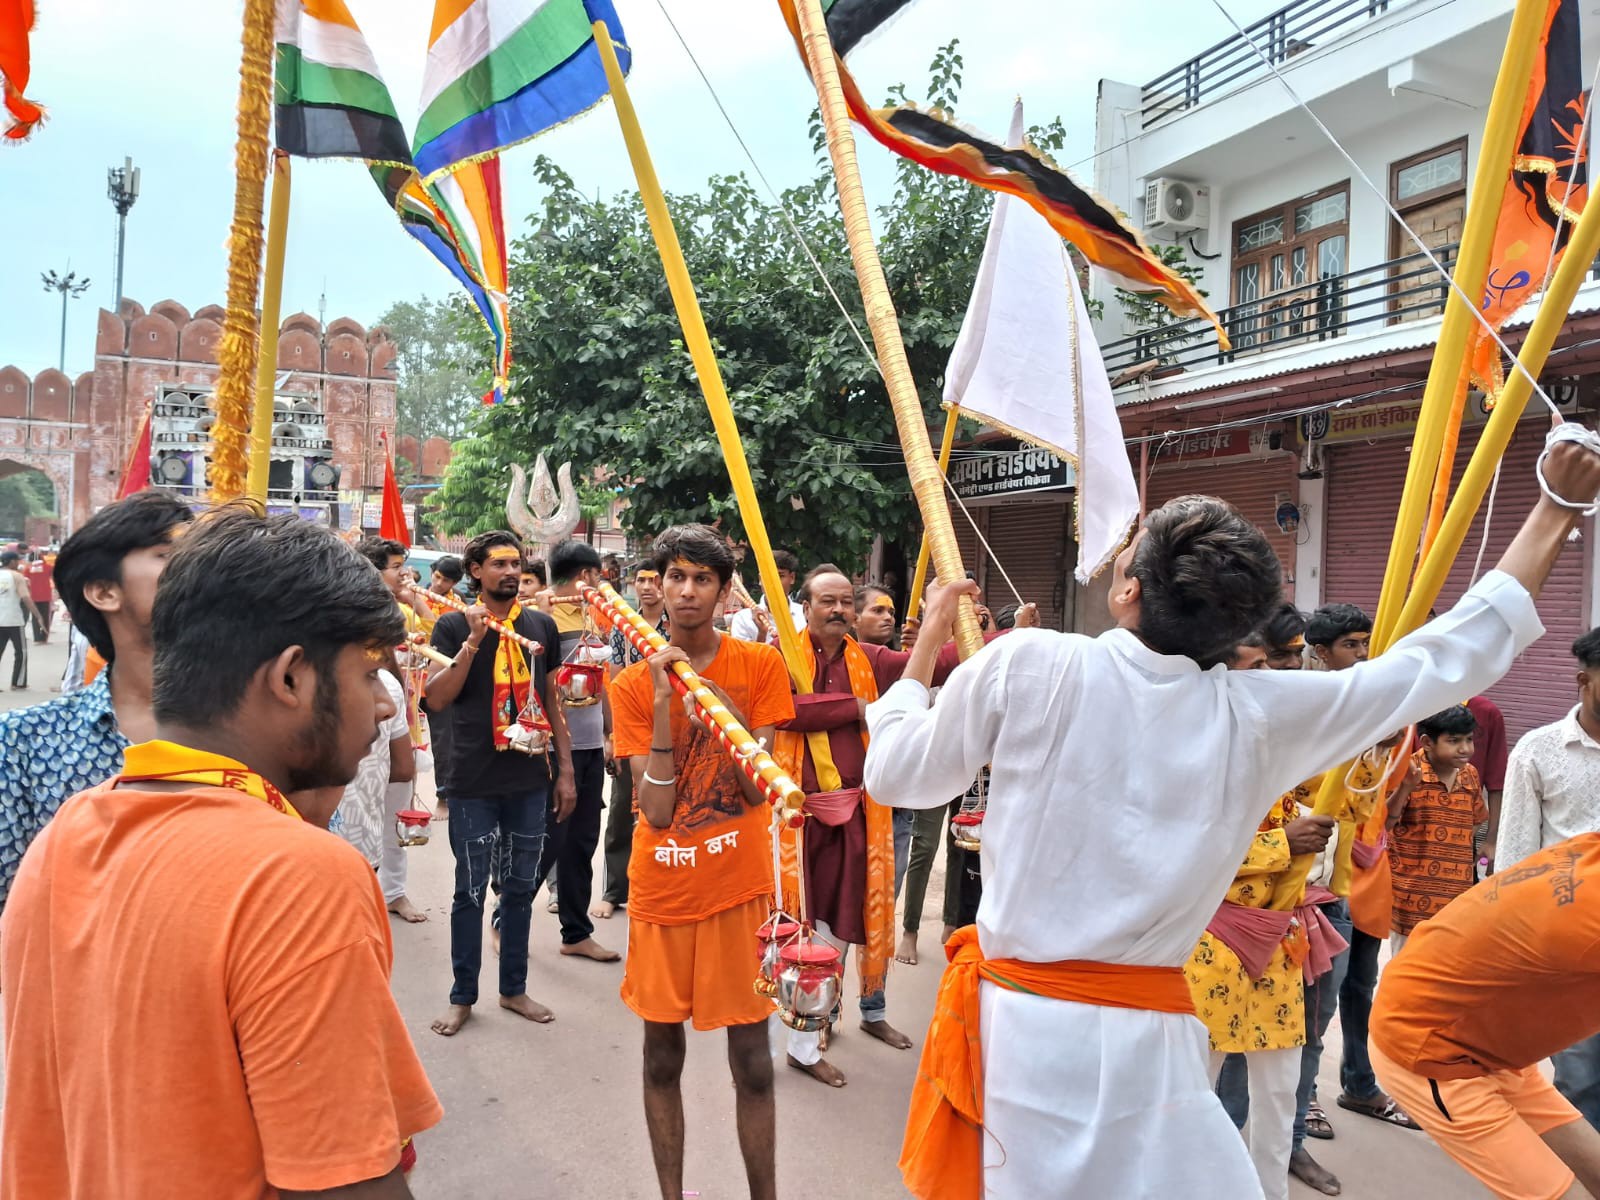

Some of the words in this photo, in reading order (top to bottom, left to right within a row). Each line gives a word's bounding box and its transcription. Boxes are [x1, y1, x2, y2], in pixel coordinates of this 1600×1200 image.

[1332, 414, 1358, 432] राम
[654, 838, 698, 868] बोल
[704, 830, 740, 855] बम
